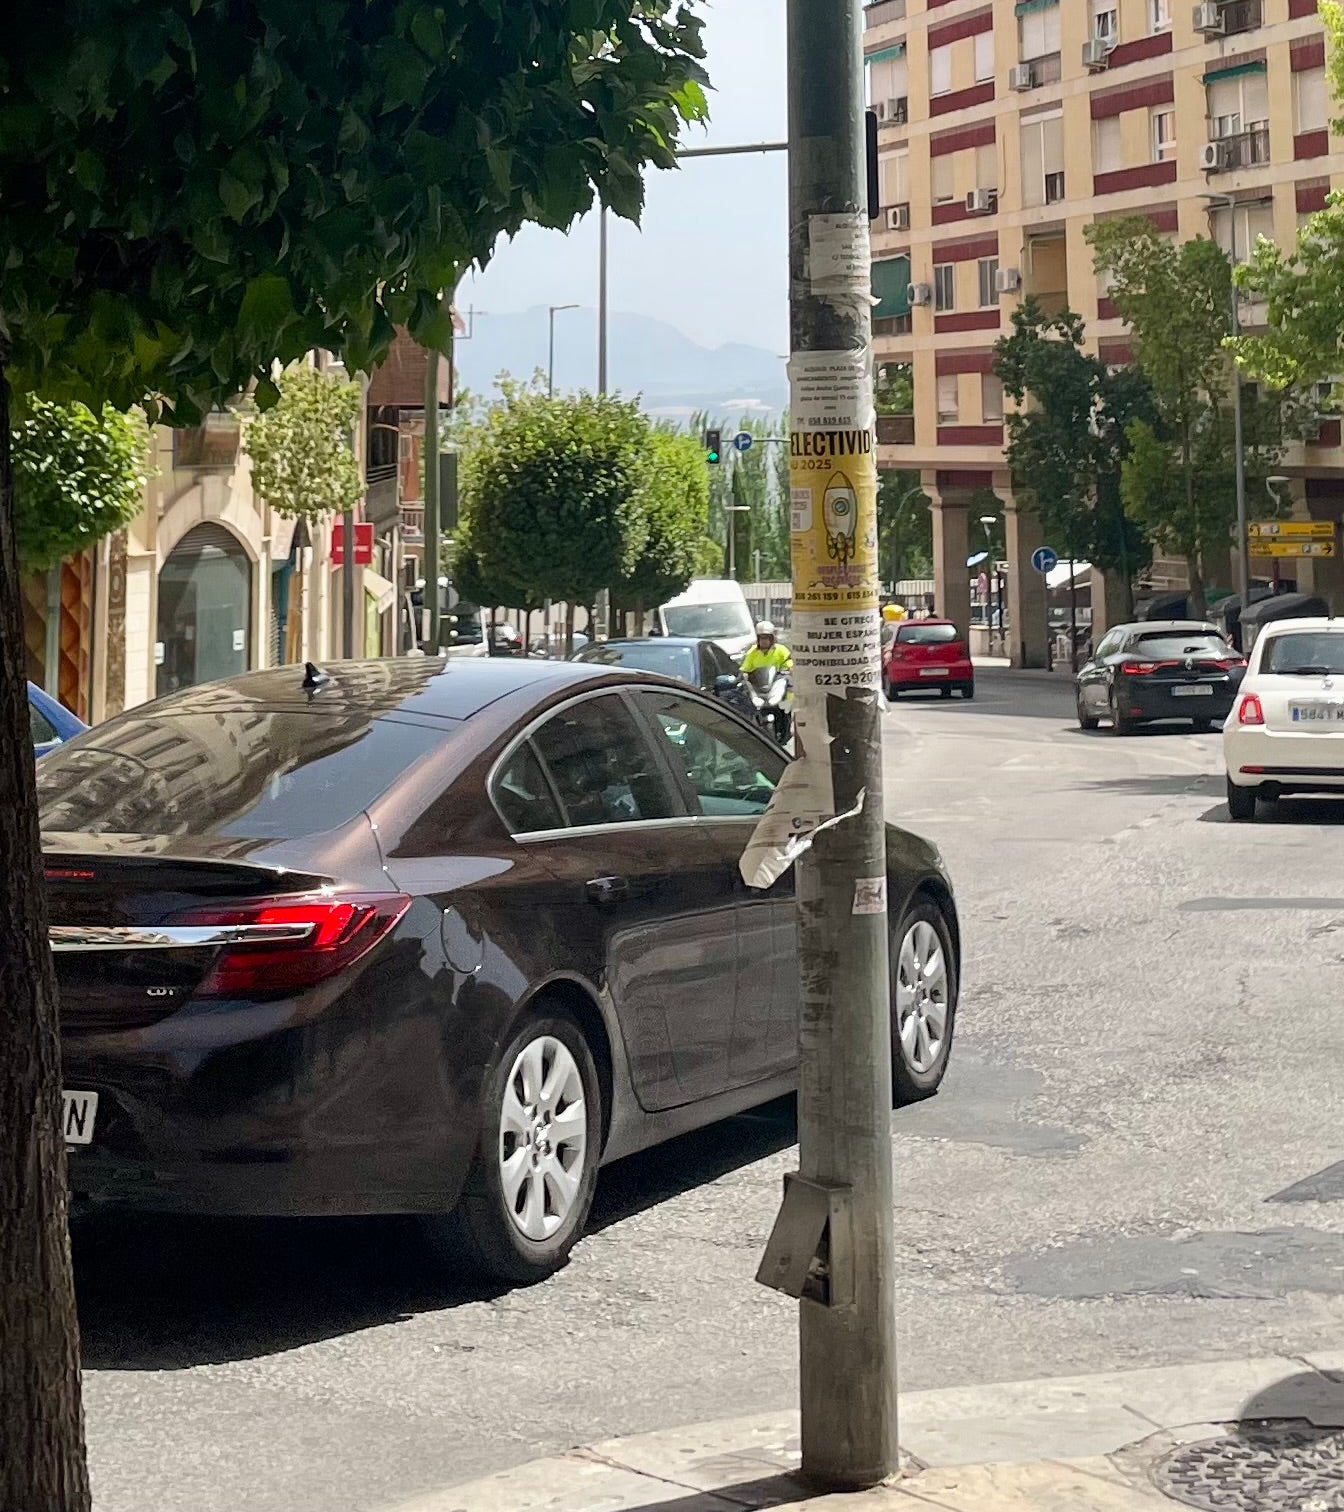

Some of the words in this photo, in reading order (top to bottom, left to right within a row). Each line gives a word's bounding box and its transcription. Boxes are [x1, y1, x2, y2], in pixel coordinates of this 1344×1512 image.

[801, 459, 832, 470] 2025
[824, 617, 837, 626] SE
[807, 631, 843, 640] MUJER
[813, 644, 860, 653] LIMPIEZA
